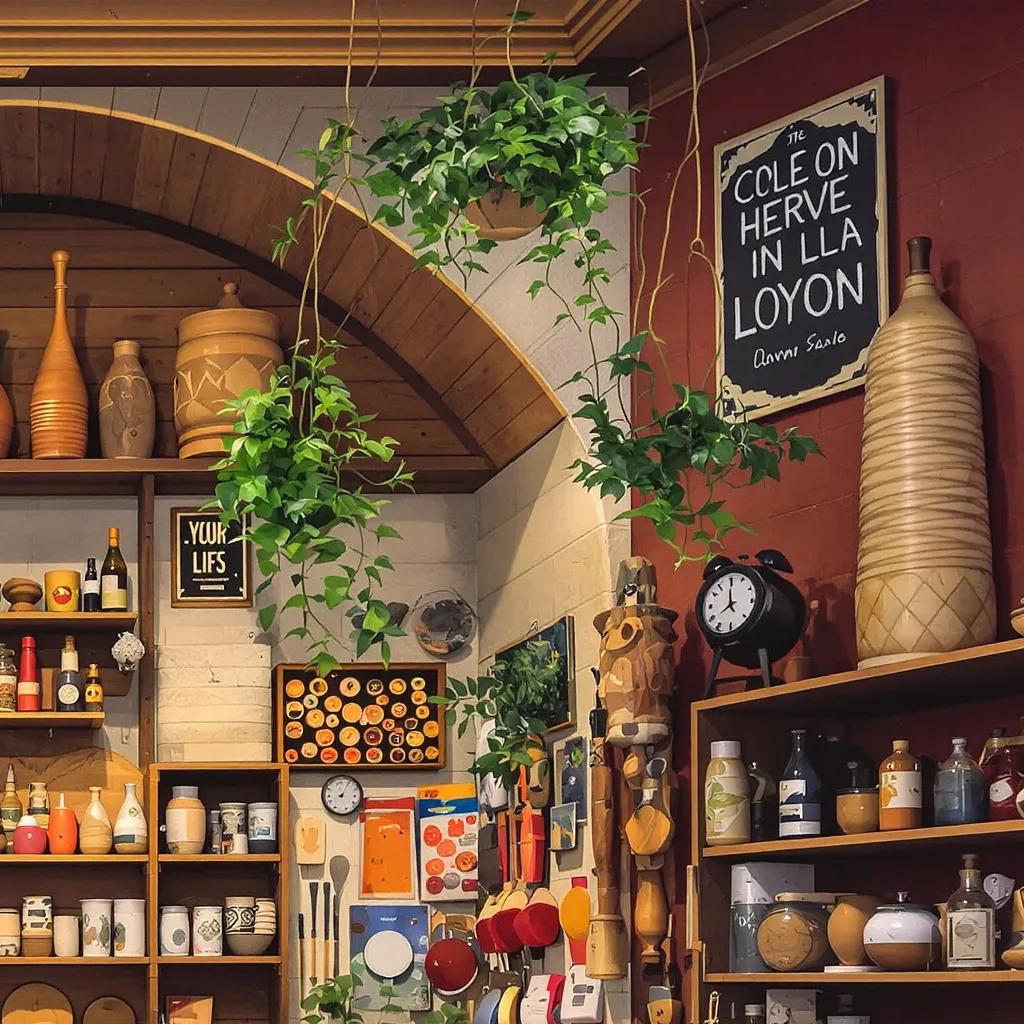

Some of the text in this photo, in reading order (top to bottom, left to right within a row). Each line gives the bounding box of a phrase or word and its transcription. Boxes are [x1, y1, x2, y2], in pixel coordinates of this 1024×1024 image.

[734, 131, 859, 204] COLE ON
[739, 174, 852, 246] HERVE
[752, 217, 863, 279] IN LLA
[734, 262, 864, 341] LOYON
